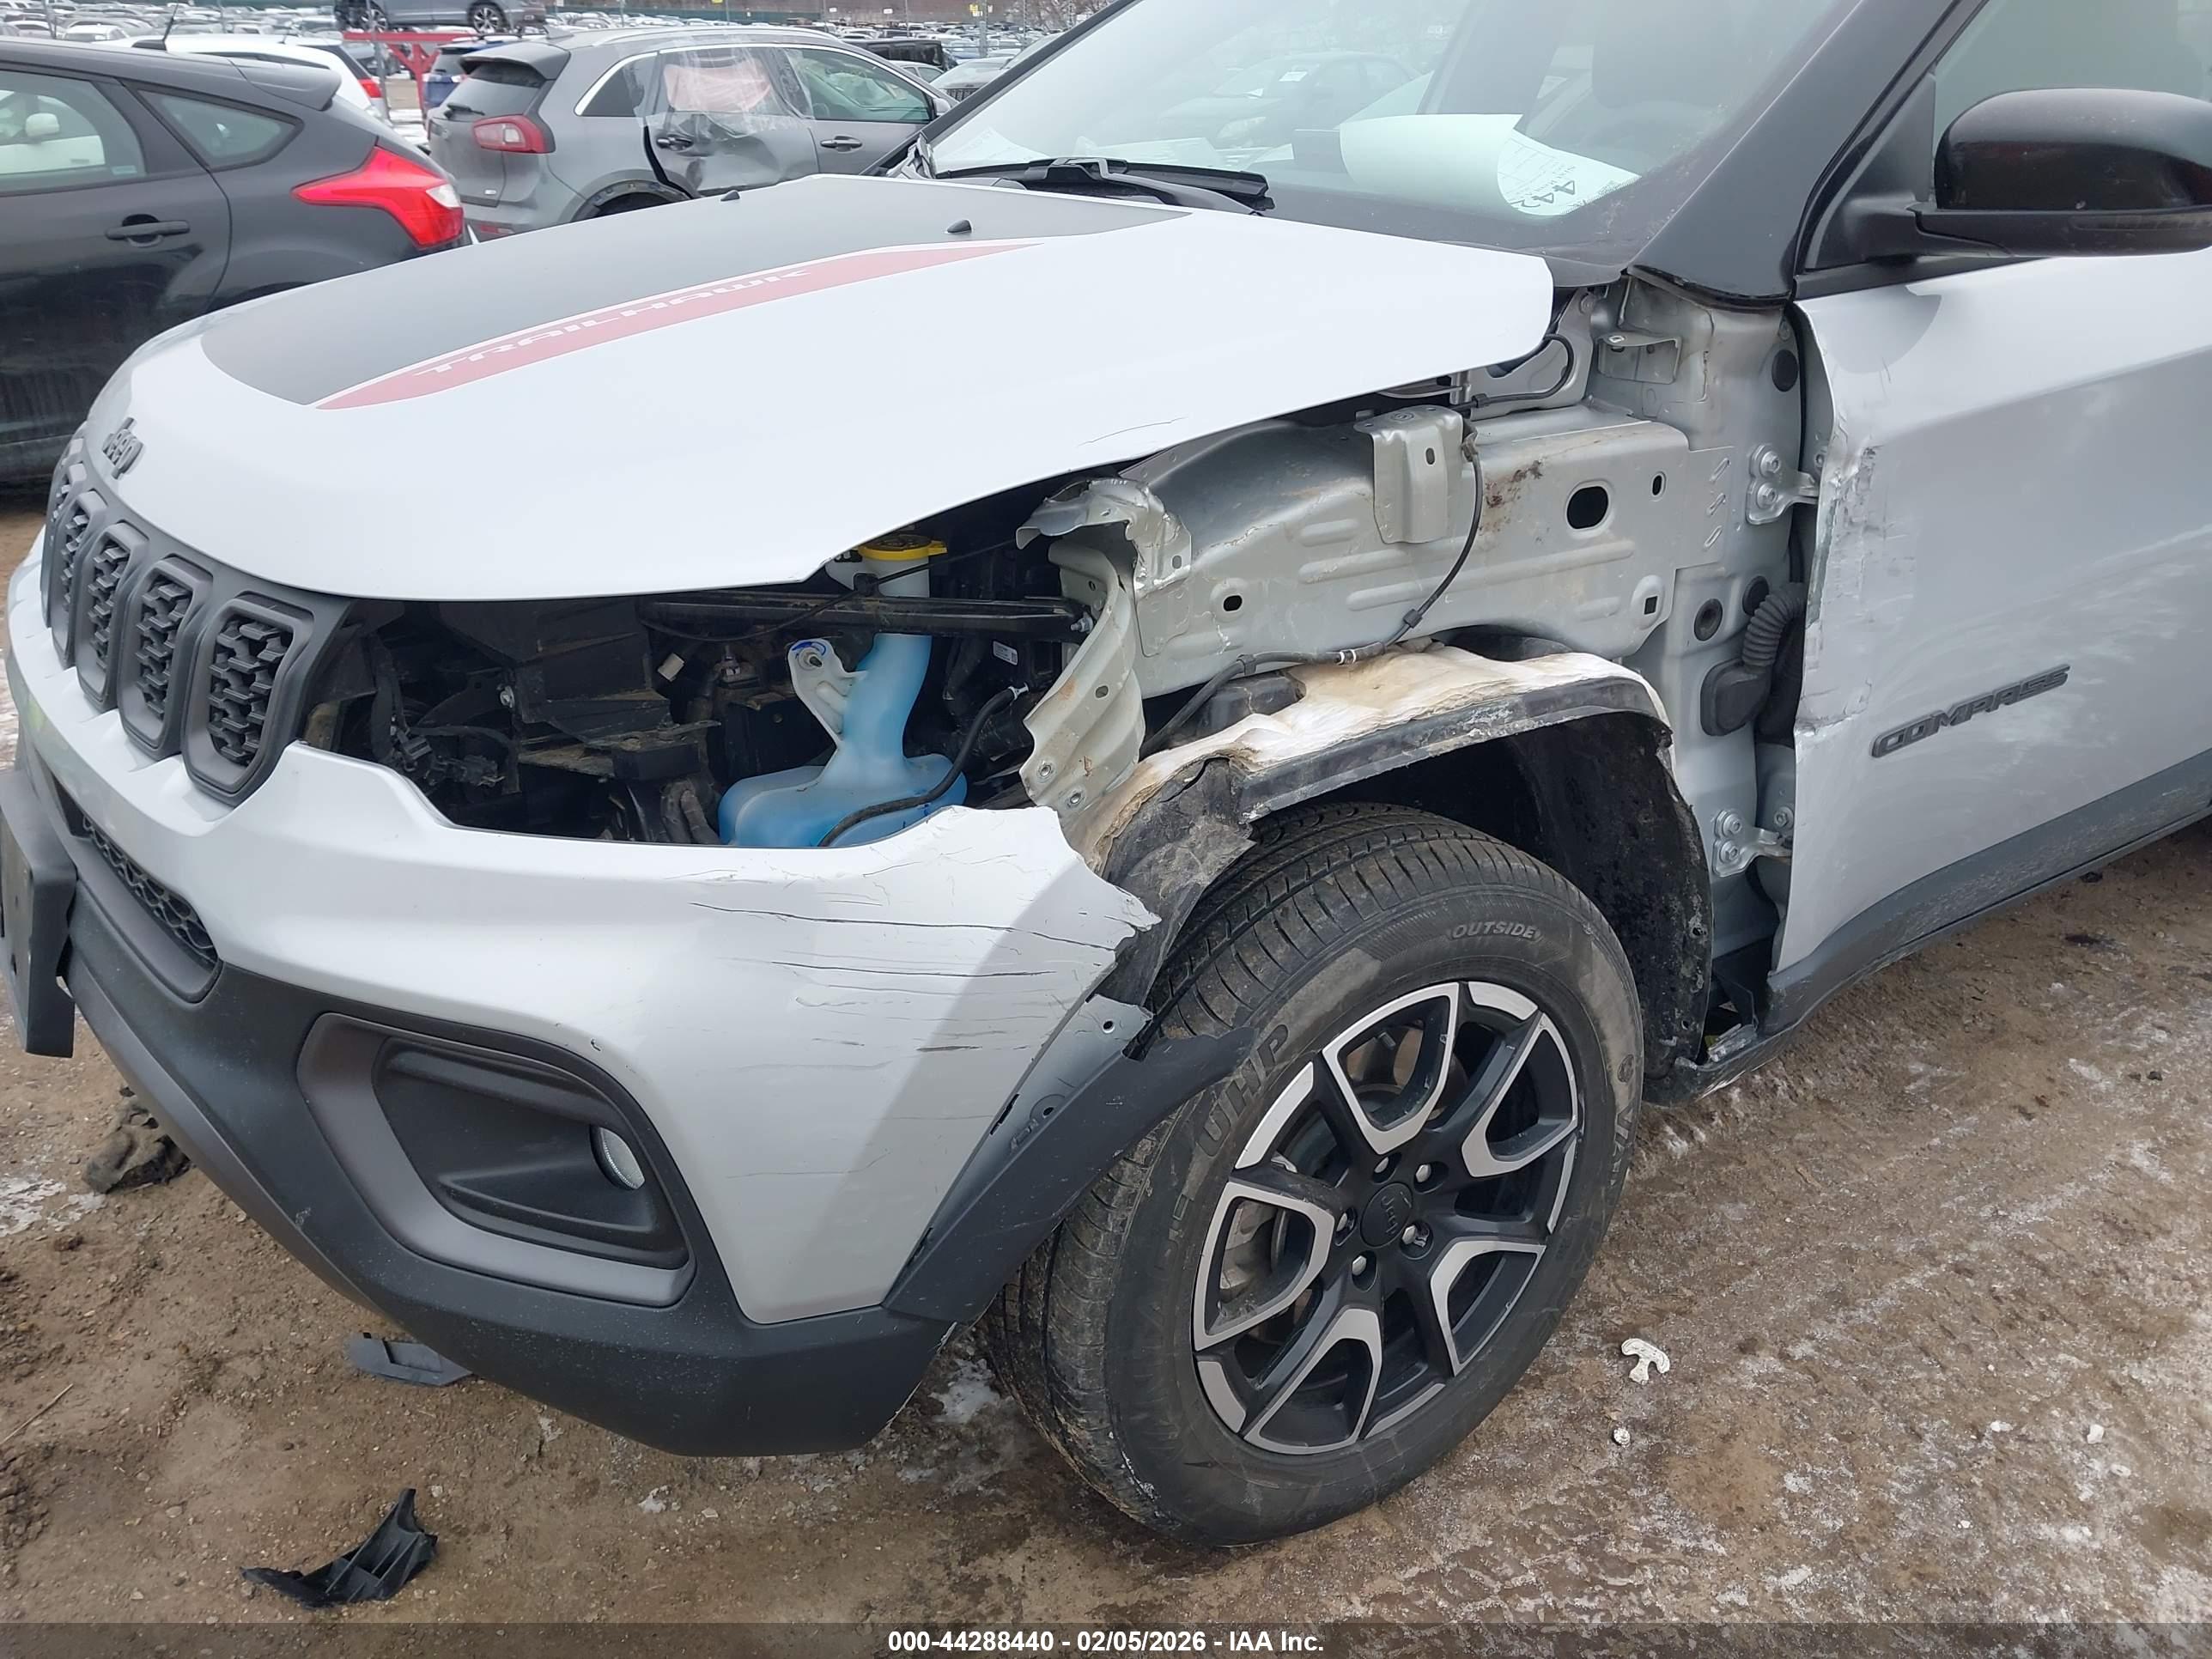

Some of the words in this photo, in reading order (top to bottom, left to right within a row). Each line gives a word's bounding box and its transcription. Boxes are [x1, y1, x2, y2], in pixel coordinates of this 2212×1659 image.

[413, 269, 811, 376] TRAILHAWK
[102, 417, 144, 480] Jeep
[1869, 664, 2071, 758] COMPASS
[1451, 921, 1537, 939] OUTSIDE
